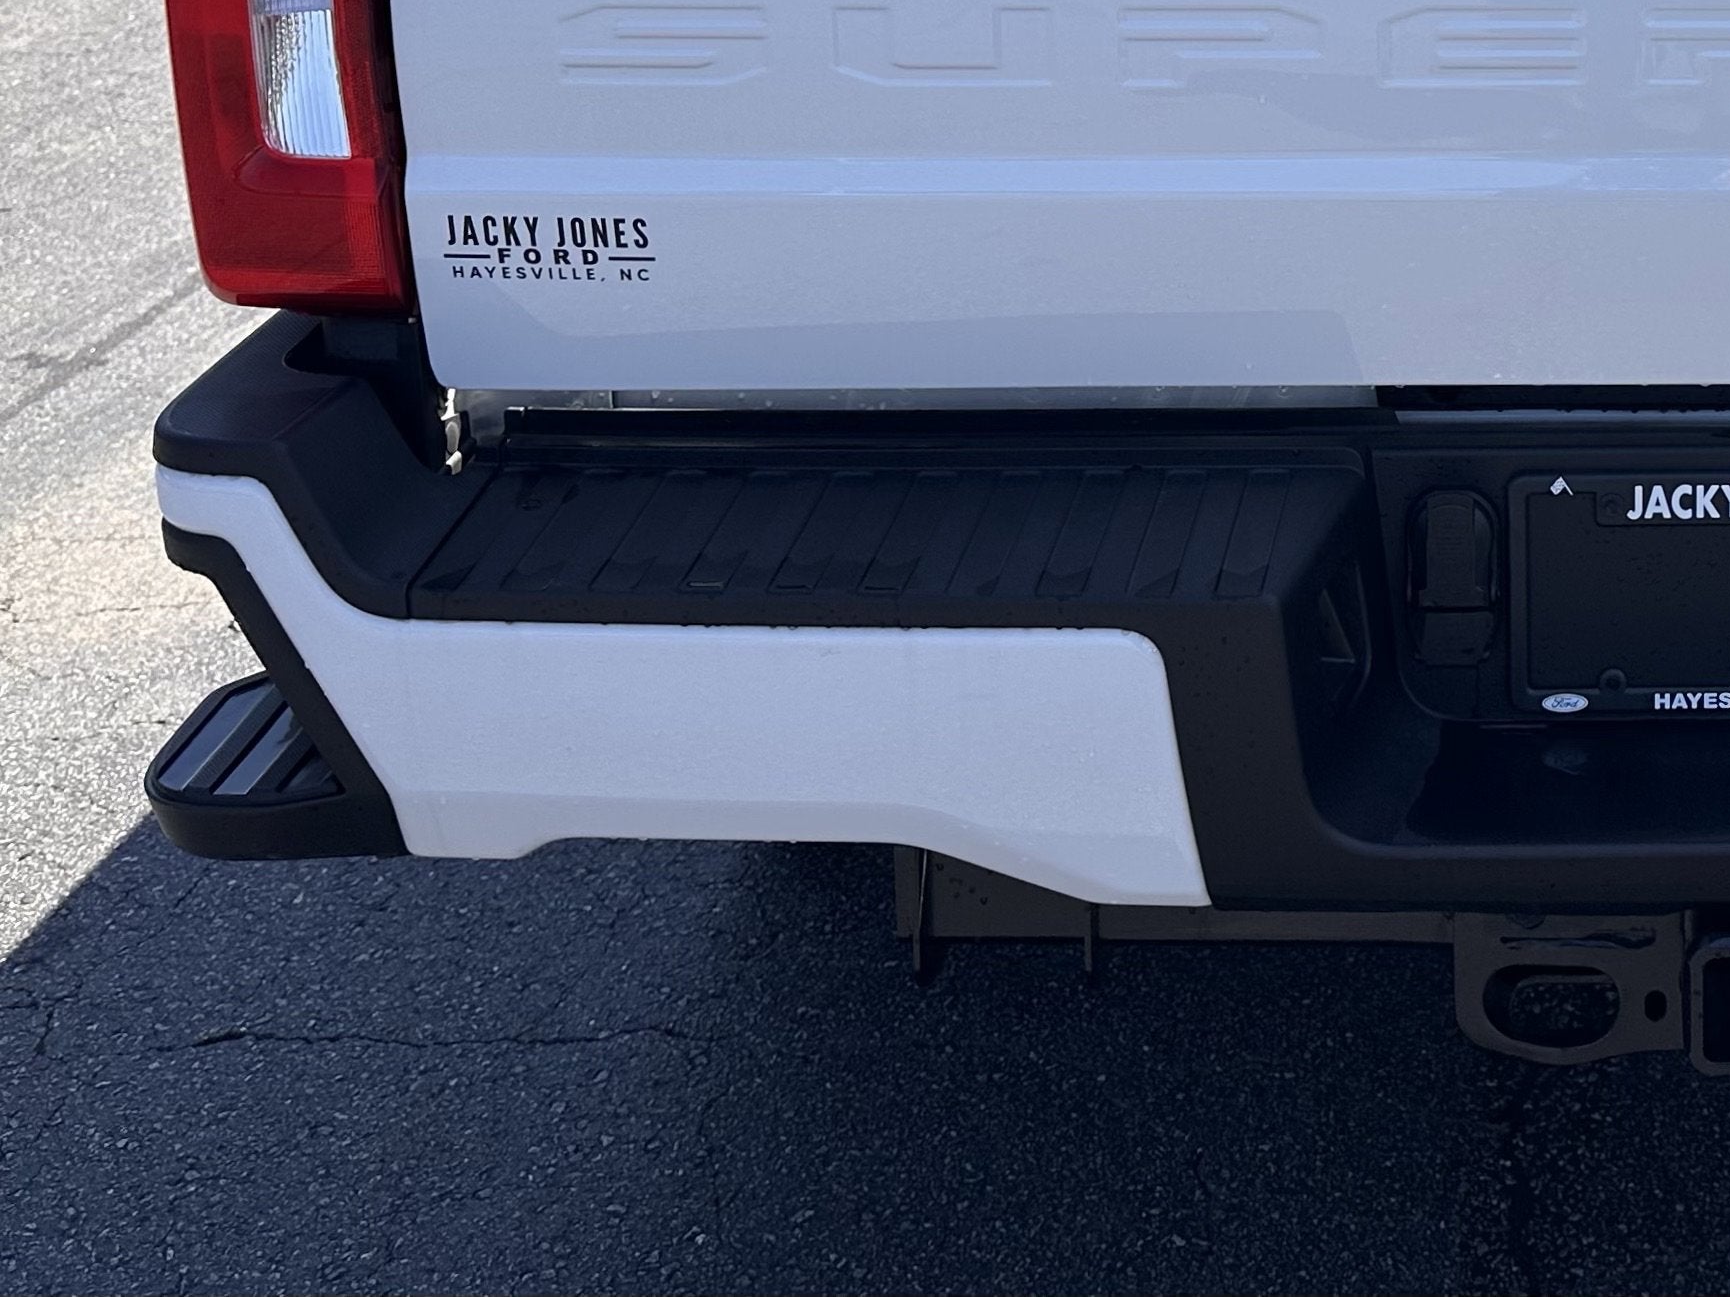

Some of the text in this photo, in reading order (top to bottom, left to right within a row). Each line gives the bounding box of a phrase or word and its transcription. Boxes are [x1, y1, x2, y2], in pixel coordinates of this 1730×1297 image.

[447, 214, 649, 249] JACKY JONES
[497, 248, 599, 265] FORD
[452, 265, 650, 282] HAYESVILLE, NC
